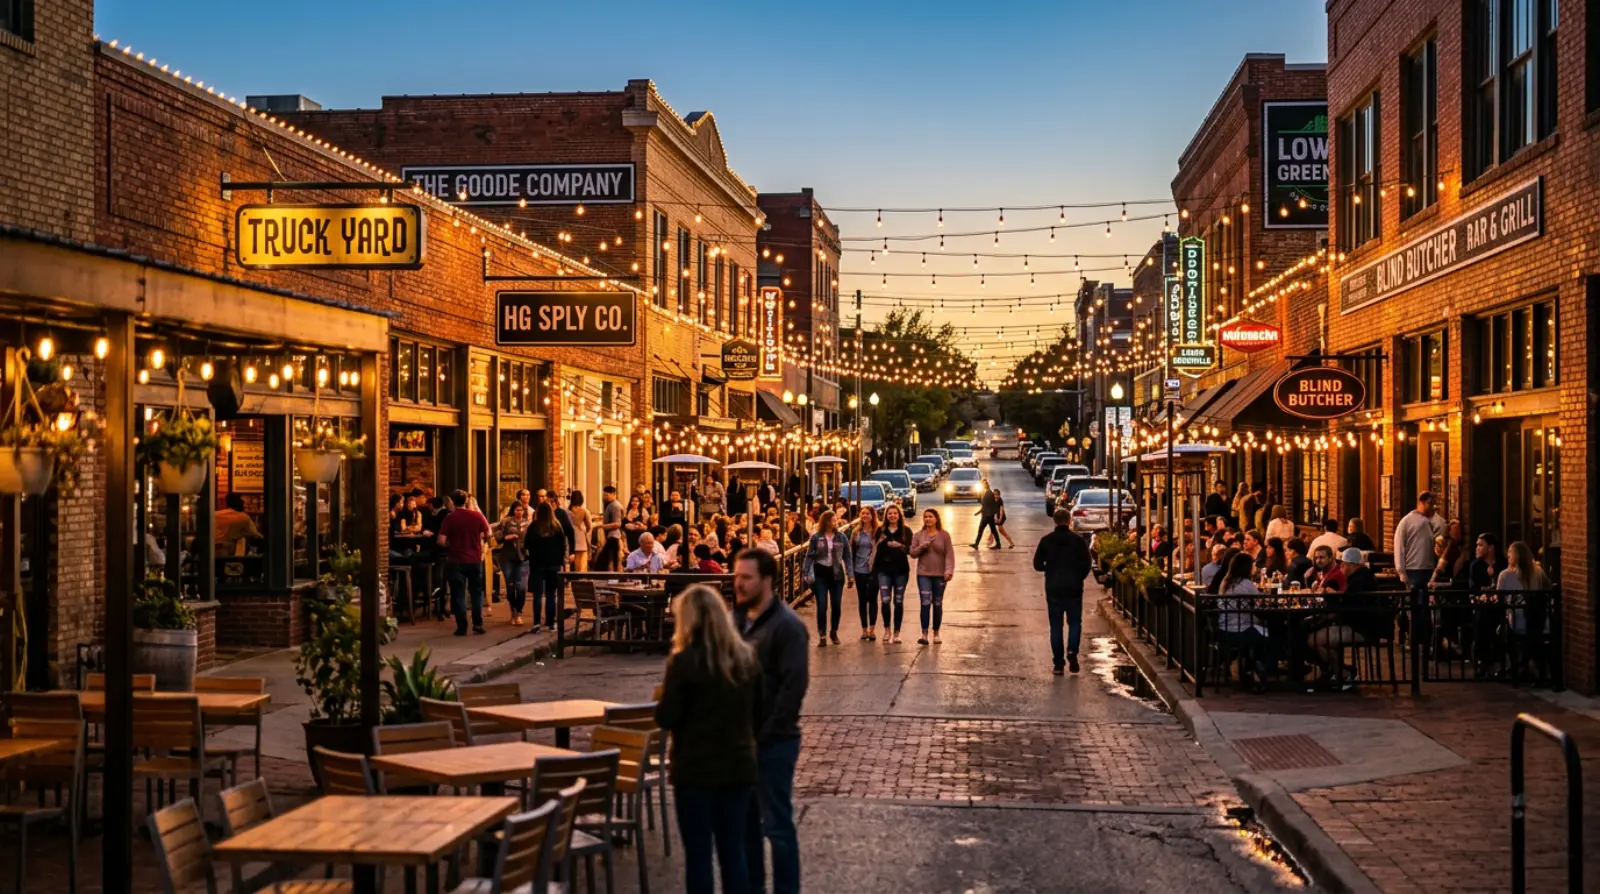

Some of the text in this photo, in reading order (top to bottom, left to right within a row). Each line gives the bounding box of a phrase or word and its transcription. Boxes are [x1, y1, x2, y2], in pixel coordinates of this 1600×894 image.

[411, 172, 623, 197] THE GOODE COMPANY
[248, 217, 406, 256] TRUCK YARD
[1377, 256, 1404, 293] BLIND
[1406, 228, 1456, 281] BUTCHER
[1501, 193, 1535, 236] GRILL
[504, 305, 628, 331] HG SPLY CO.
[1300, 380, 1342, 392] BLIND
[1289, 394, 1353, 406] BUTCHER
